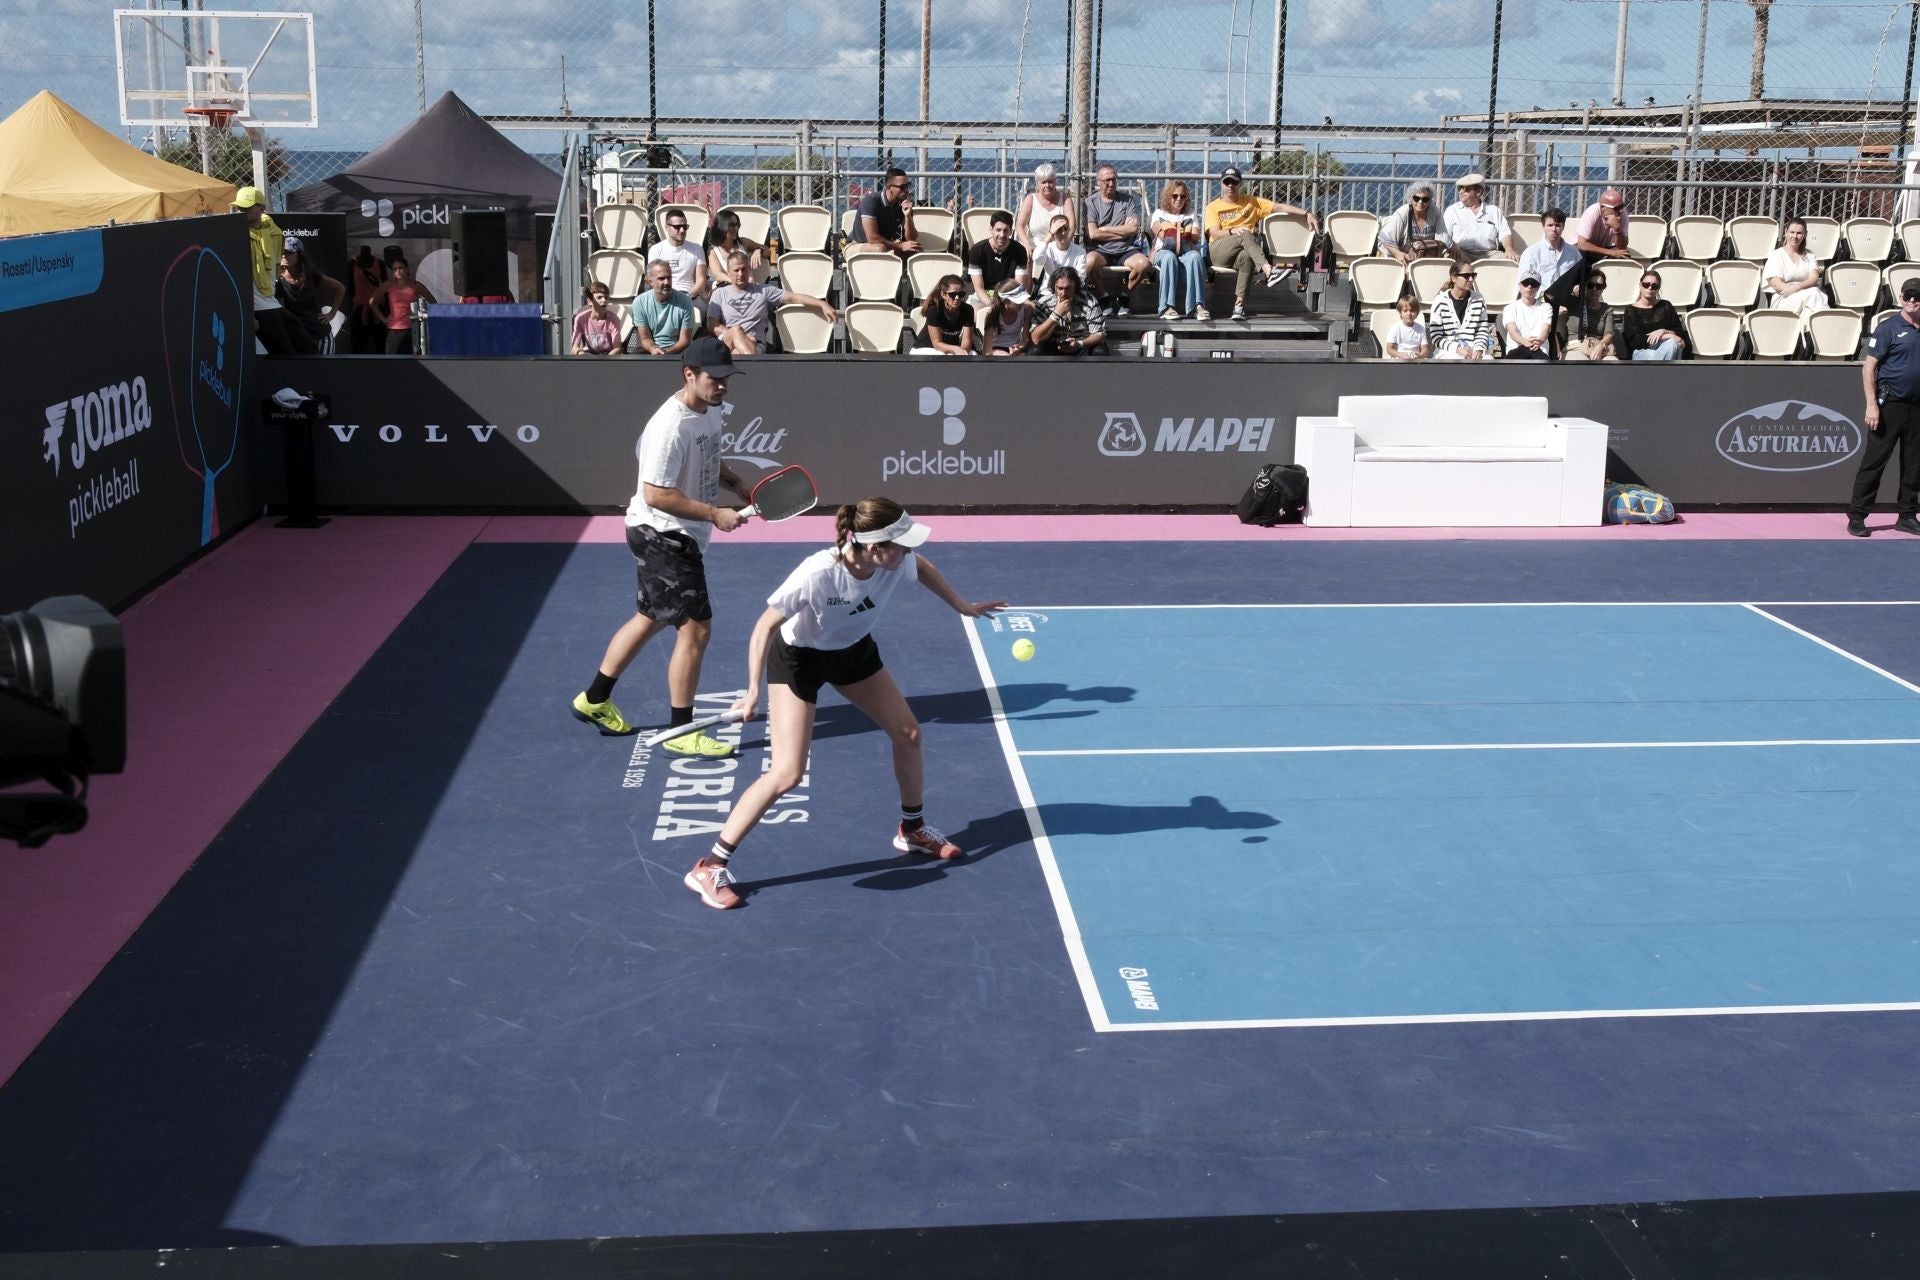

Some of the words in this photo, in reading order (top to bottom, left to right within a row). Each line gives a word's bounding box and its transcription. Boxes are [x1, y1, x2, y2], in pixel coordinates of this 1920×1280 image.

[328, 424, 540, 443] VOLVO
[1153, 417, 1276, 452] MAPEI
[1727, 426, 1850, 453] ASTURIANA
[1750, 424, 1796, 432] CENTRAL
[1801, 424, 1848, 432] LECHERA
[882, 449, 1005, 482] picklebull
[69, 457, 141, 539] pickleball
[622, 768, 647, 789] 1928
